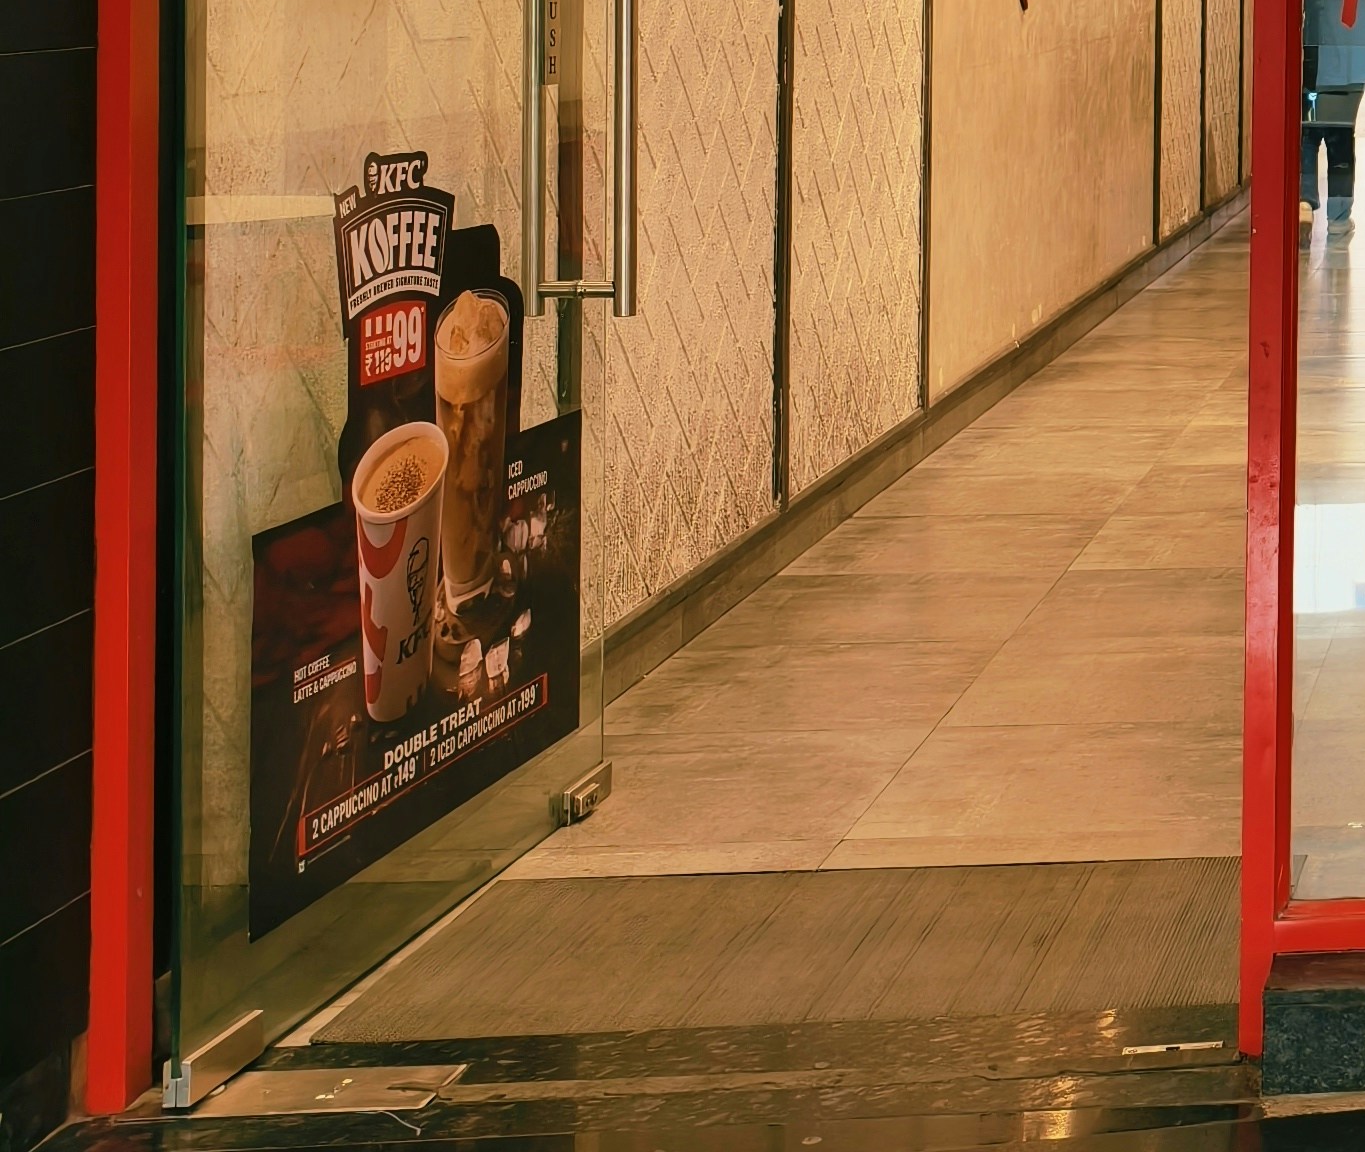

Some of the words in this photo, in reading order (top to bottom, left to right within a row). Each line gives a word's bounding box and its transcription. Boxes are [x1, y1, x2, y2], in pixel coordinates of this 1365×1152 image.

[378, 160, 421, 195] KFC
[339, 192, 357, 219] NEW
[350, 288, 371, 311] FRESHLY
[396, 276, 423, 287] SIGNATURE
[424, 277, 439, 289] TASTE
[508, 460, 523, 480] ICED
[508, 470, 548, 500] CAPPUCCINO
[294, 666, 307, 684] HOT
[307, 654, 331, 676] COFFEE
[294, 683, 313, 704] LATTE
[314, 681, 319, 694] &
[319, 661, 357, 691] CAPPUCCINO
[384, 723, 438, 771] DOUBLE
[440, 697, 483, 737] TREAT
[430, 748, 436, 767] 2
[437, 735, 456, 762] ICED
[457, 707, 506, 750] CAPPUCCINO
[507, 698, 517, 720] AT
[312, 818, 319, 840] 2
[320, 784, 380, 835] CAPPUCCINO
[381, 773, 392, 796] AT
